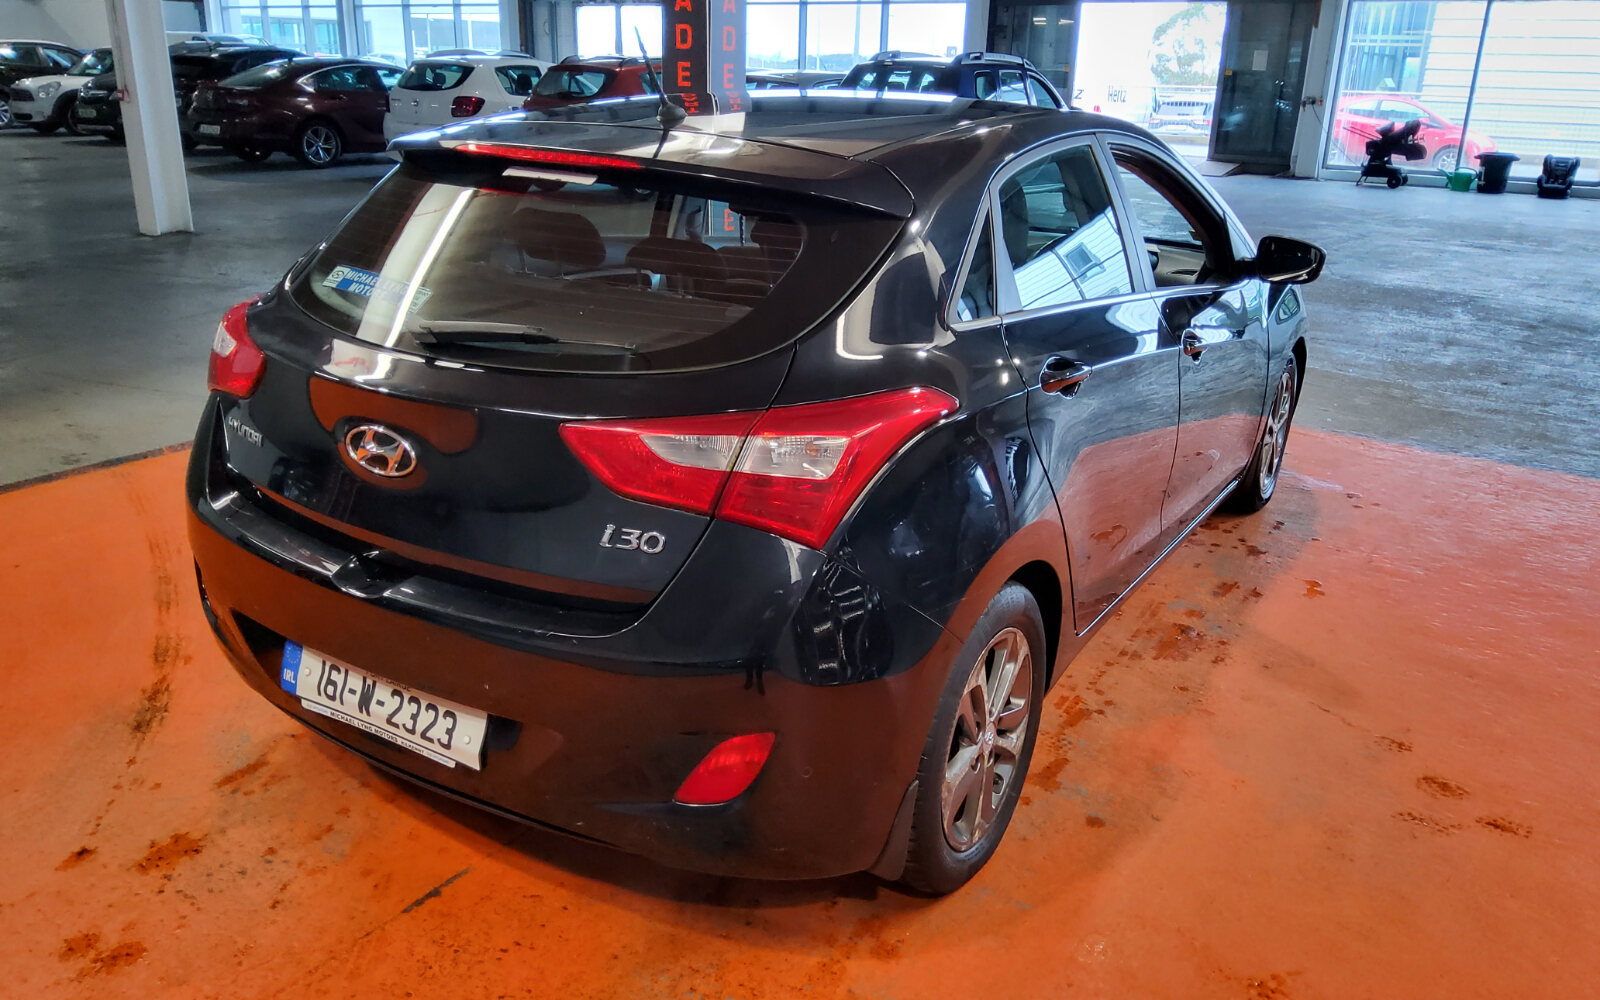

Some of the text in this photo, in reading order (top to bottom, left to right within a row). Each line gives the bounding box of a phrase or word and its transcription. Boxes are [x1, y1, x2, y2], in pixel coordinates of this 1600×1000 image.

[1107, 84, 1127, 103] Hertz
[347, 281, 378, 297] MOTO
[283, 668, 296, 684] IRL
[317, 659, 458, 750] 161-W-2323
[330, 711, 356, 726] MICHAEL
[357, 721, 373, 732] LYNG
[374, 728, 399, 743] MOTORS
